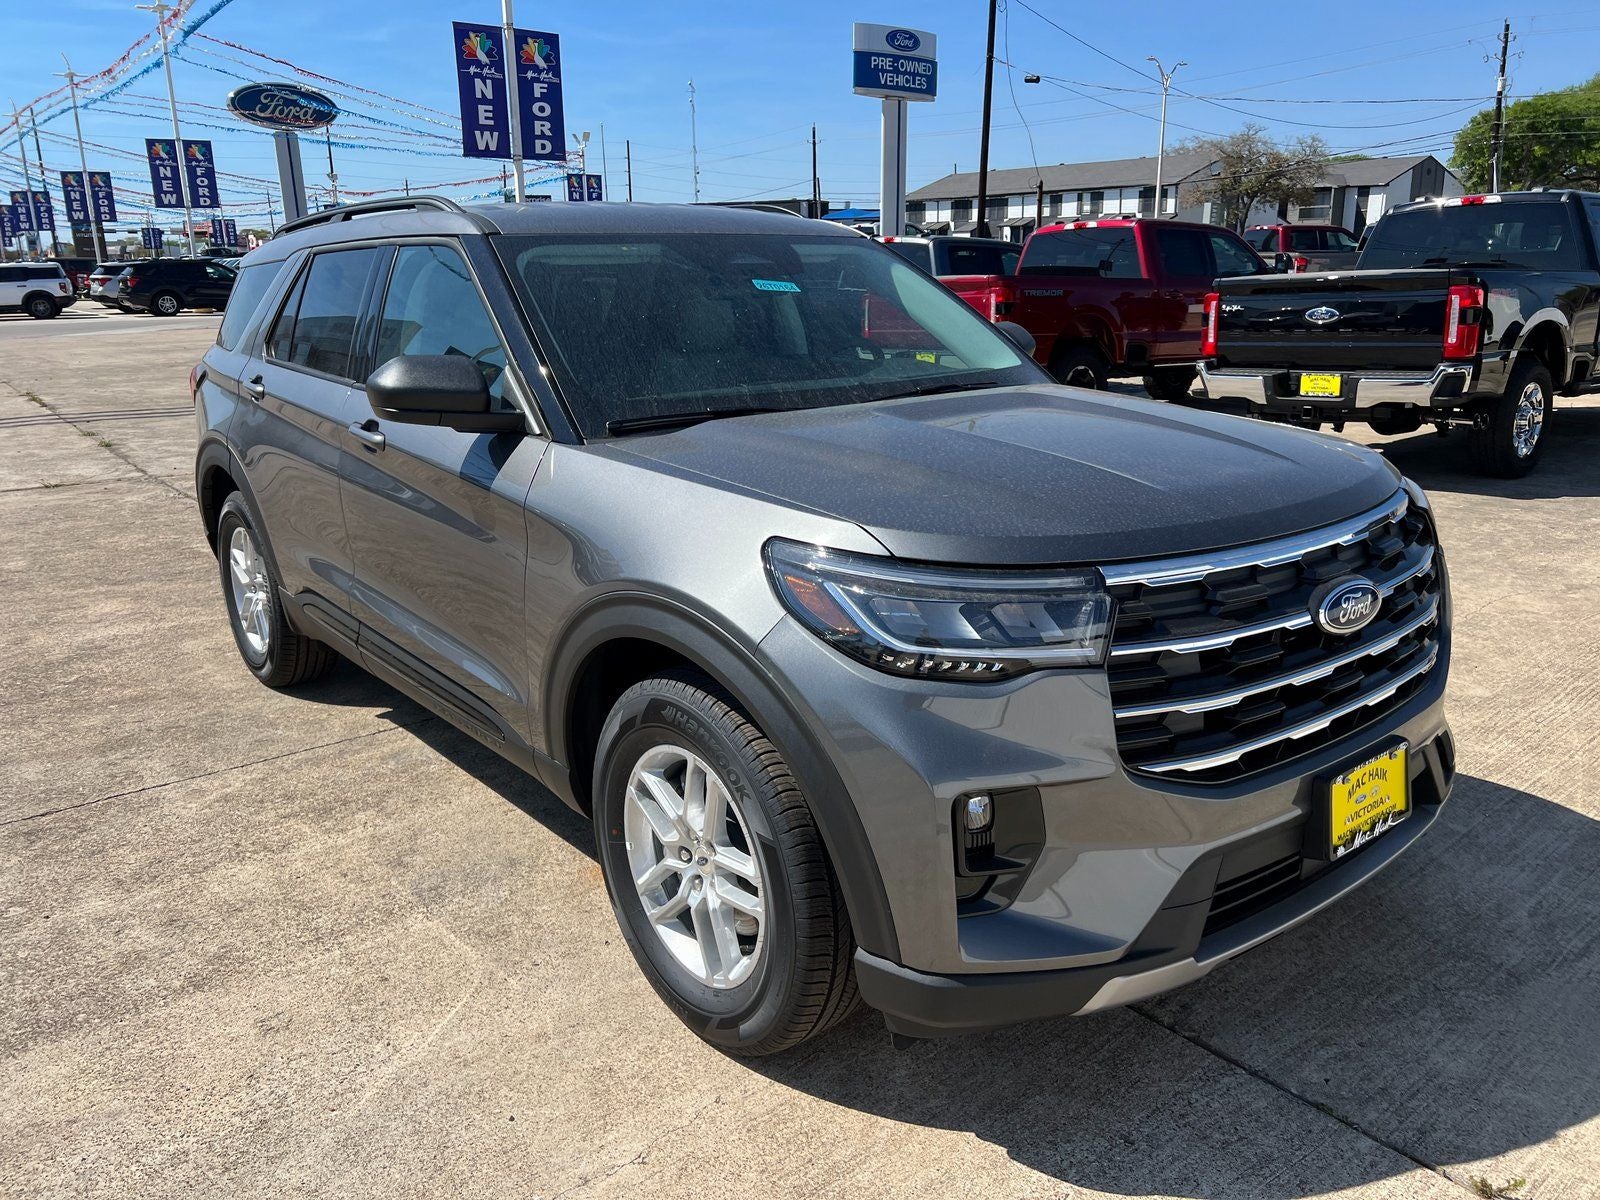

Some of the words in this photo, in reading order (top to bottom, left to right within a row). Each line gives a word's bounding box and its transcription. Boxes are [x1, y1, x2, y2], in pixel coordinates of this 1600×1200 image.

[895, 32, 915, 47] Ford
[871, 56, 932, 75] PRE-OWNED
[879, 72, 927, 89] VEHICLES
[256, 91, 316, 120] Ford
[474, 78, 499, 151] NEW
[532, 82, 552, 154] FORD
[159, 166, 177, 205] NEW
[196, 168, 211, 206] FORD
[70, 191, 84, 220] NEW
[98, 191, 111, 220] FORD
[1023, 289, 1064, 297] TREMOR
[1340, 591, 1371, 623] Ford
[1347, 772, 1367, 804] MAC
[1368, 767, 1388, 783] HAIK
[1349, 797, 1385, 823] VICTORIA
